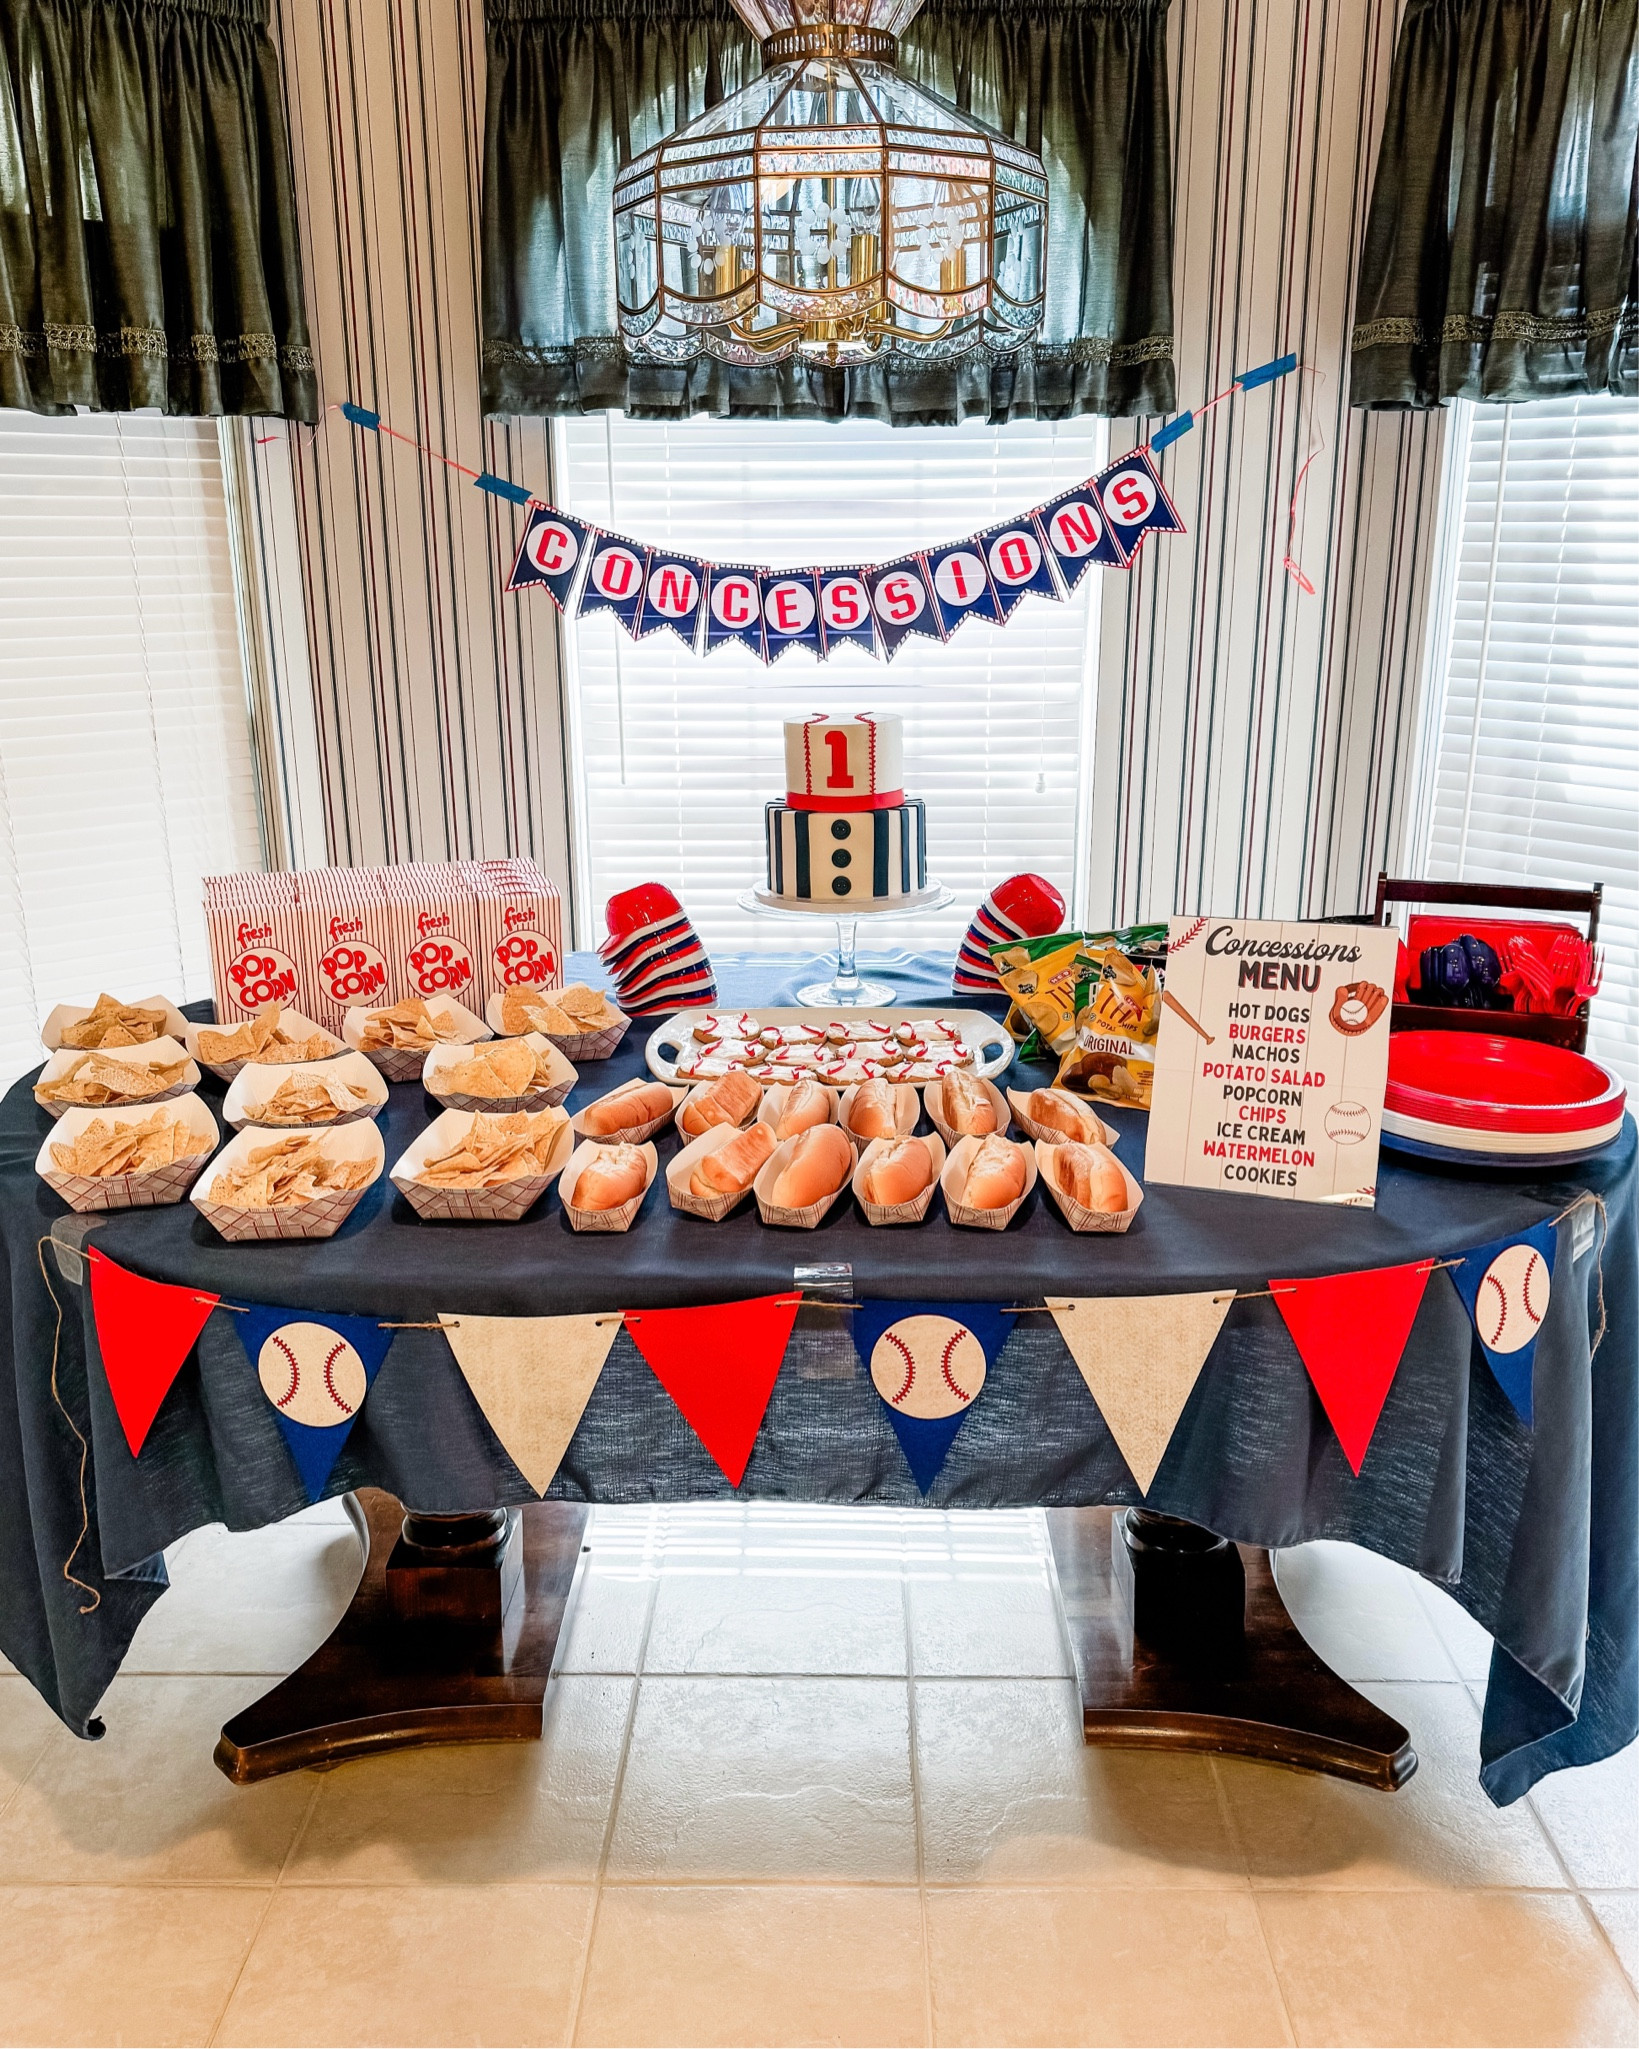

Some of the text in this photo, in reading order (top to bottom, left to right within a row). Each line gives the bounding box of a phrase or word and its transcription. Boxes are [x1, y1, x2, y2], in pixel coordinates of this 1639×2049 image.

[535, 477, 1149, 629] CONCESSIONS
[824, 730, 855, 789] 1
[328, 916, 364, 943] fresh
[416, 911, 450, 938] fresh
[503, 906, 536, 932] fresh
[236, 922, 273, 950] fresh
[1205, 925, 1362, 963] Concessions
[321, 947, 368, 981] POP
[407, 942, 454, 975] POP
[493, 936, 539, 969] POP
[229, 953, 278, 987] POP
[330, 961, 386, 1001] CORN
[417, 956, 472, 994] CORN
[503, 951, 559, 986] CORN
[1237, 959, 1321, 993] MENU
[239, 968, 297, 1008] CORN
[1228, 1002, 1310, 1024] HOT DOGS
[1083, 1034, 1135, 1056] ORIGINAL
[1228, 1023, 1306, 1045] BURGERS
[1232, 1043, 1300, 1064] NACHOS
[1202, 1061, 1326, 1088] POTATO SALAD
[1222, 1084, 1302, 1107] POPCORN
[1238, 1105, 1287, 1125] CHIPS
[1216, 1121, 1306, 1146] ICE CREAM
[1202, 1140, 1316, 1168] WATERMELON
[1223, 1164, 1298, 1187] COOKIES
